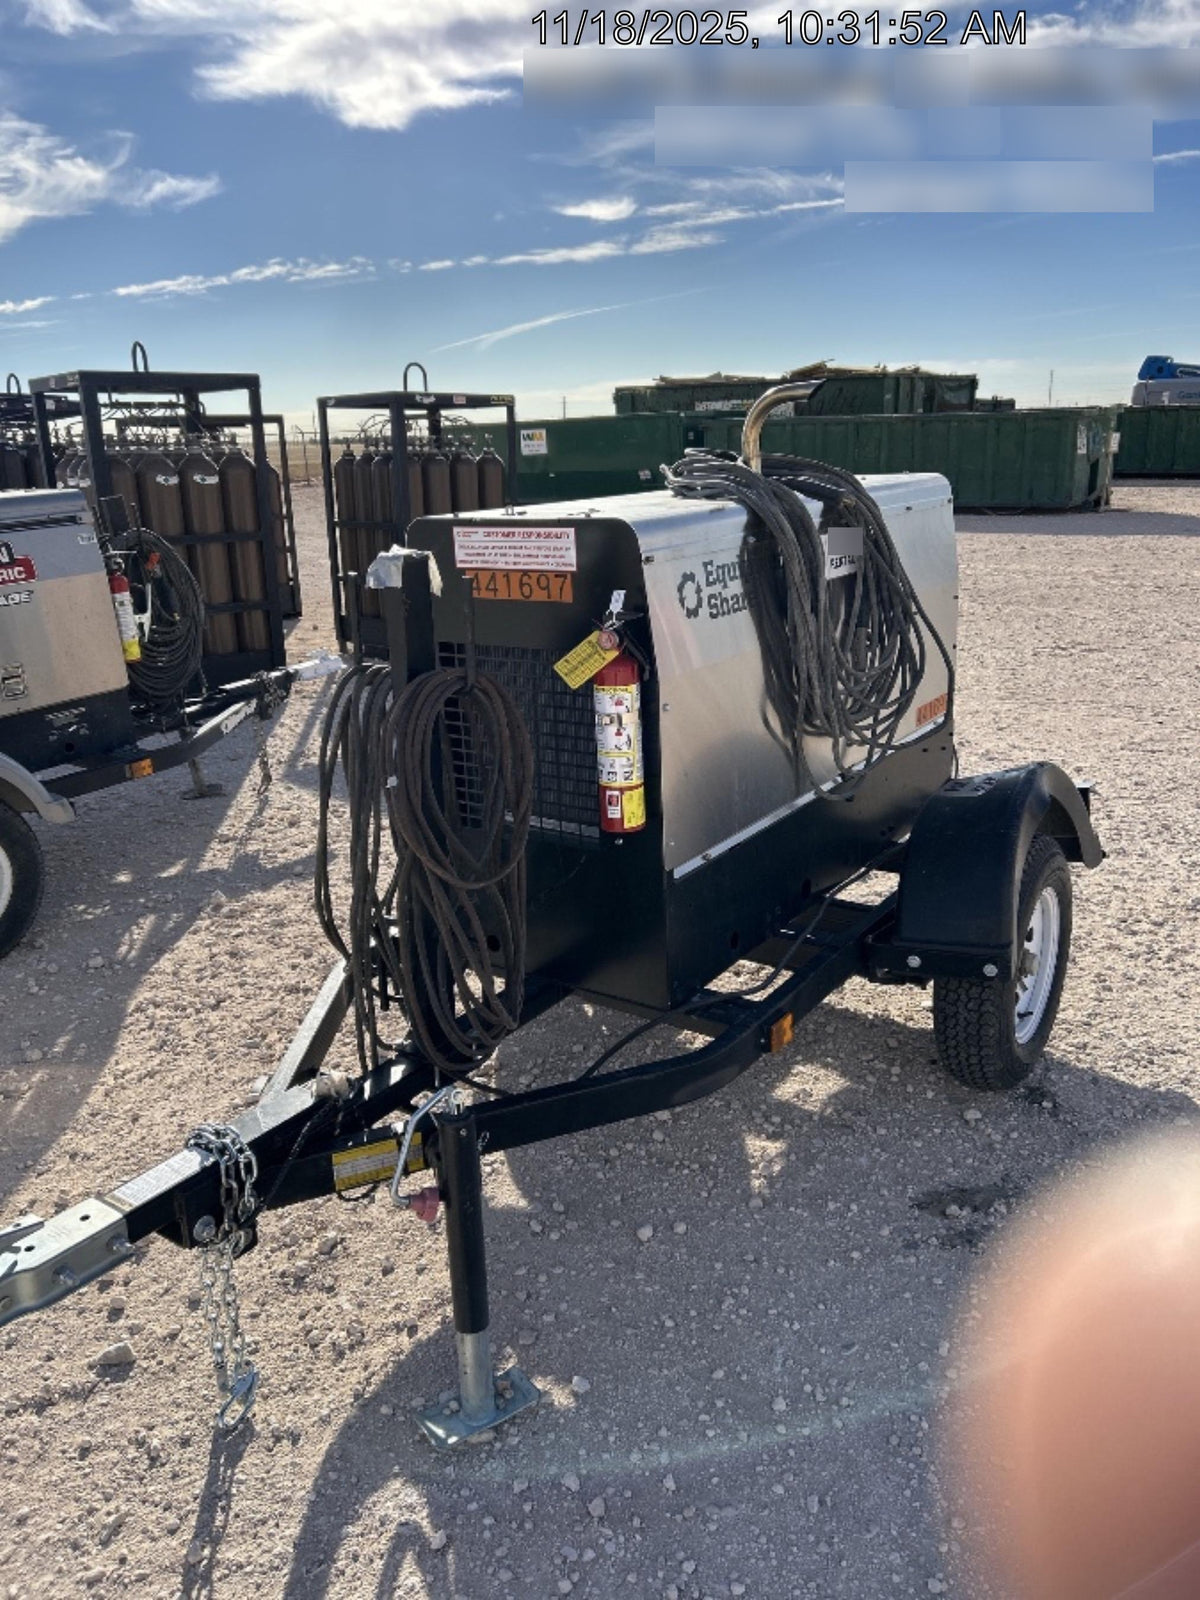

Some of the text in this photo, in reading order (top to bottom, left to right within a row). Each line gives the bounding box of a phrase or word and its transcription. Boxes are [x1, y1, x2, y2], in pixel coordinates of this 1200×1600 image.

[472, 571, 568, 600] 441697
[702, 559, 741, 590] Equ
[707, 591, 748, 619] Shar
